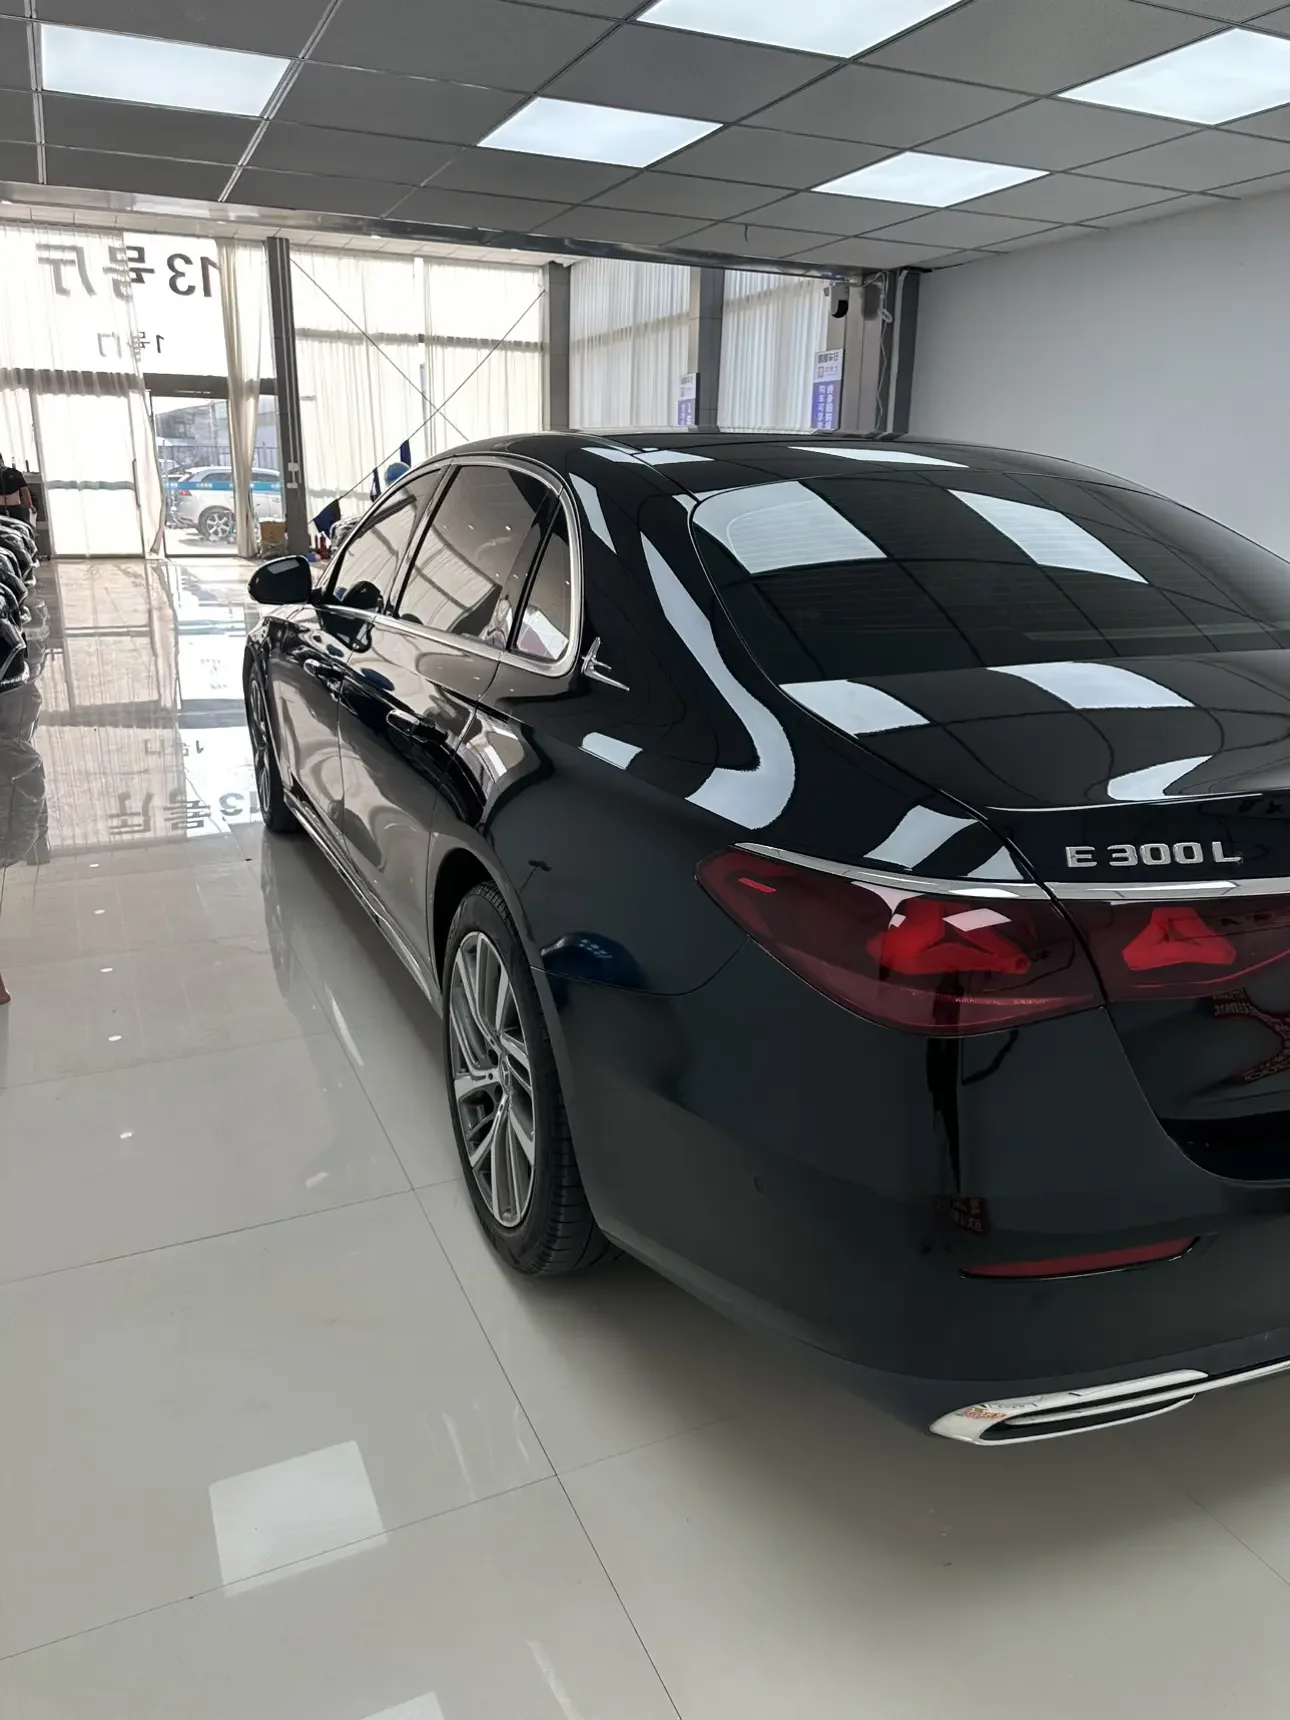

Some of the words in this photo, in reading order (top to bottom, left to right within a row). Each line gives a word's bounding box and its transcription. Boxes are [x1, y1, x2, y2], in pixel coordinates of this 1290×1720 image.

[1065, 846, 1097, 868] E
[1107, 842, 1204, 867] 300
[1212, 841, 1241, 863] L
